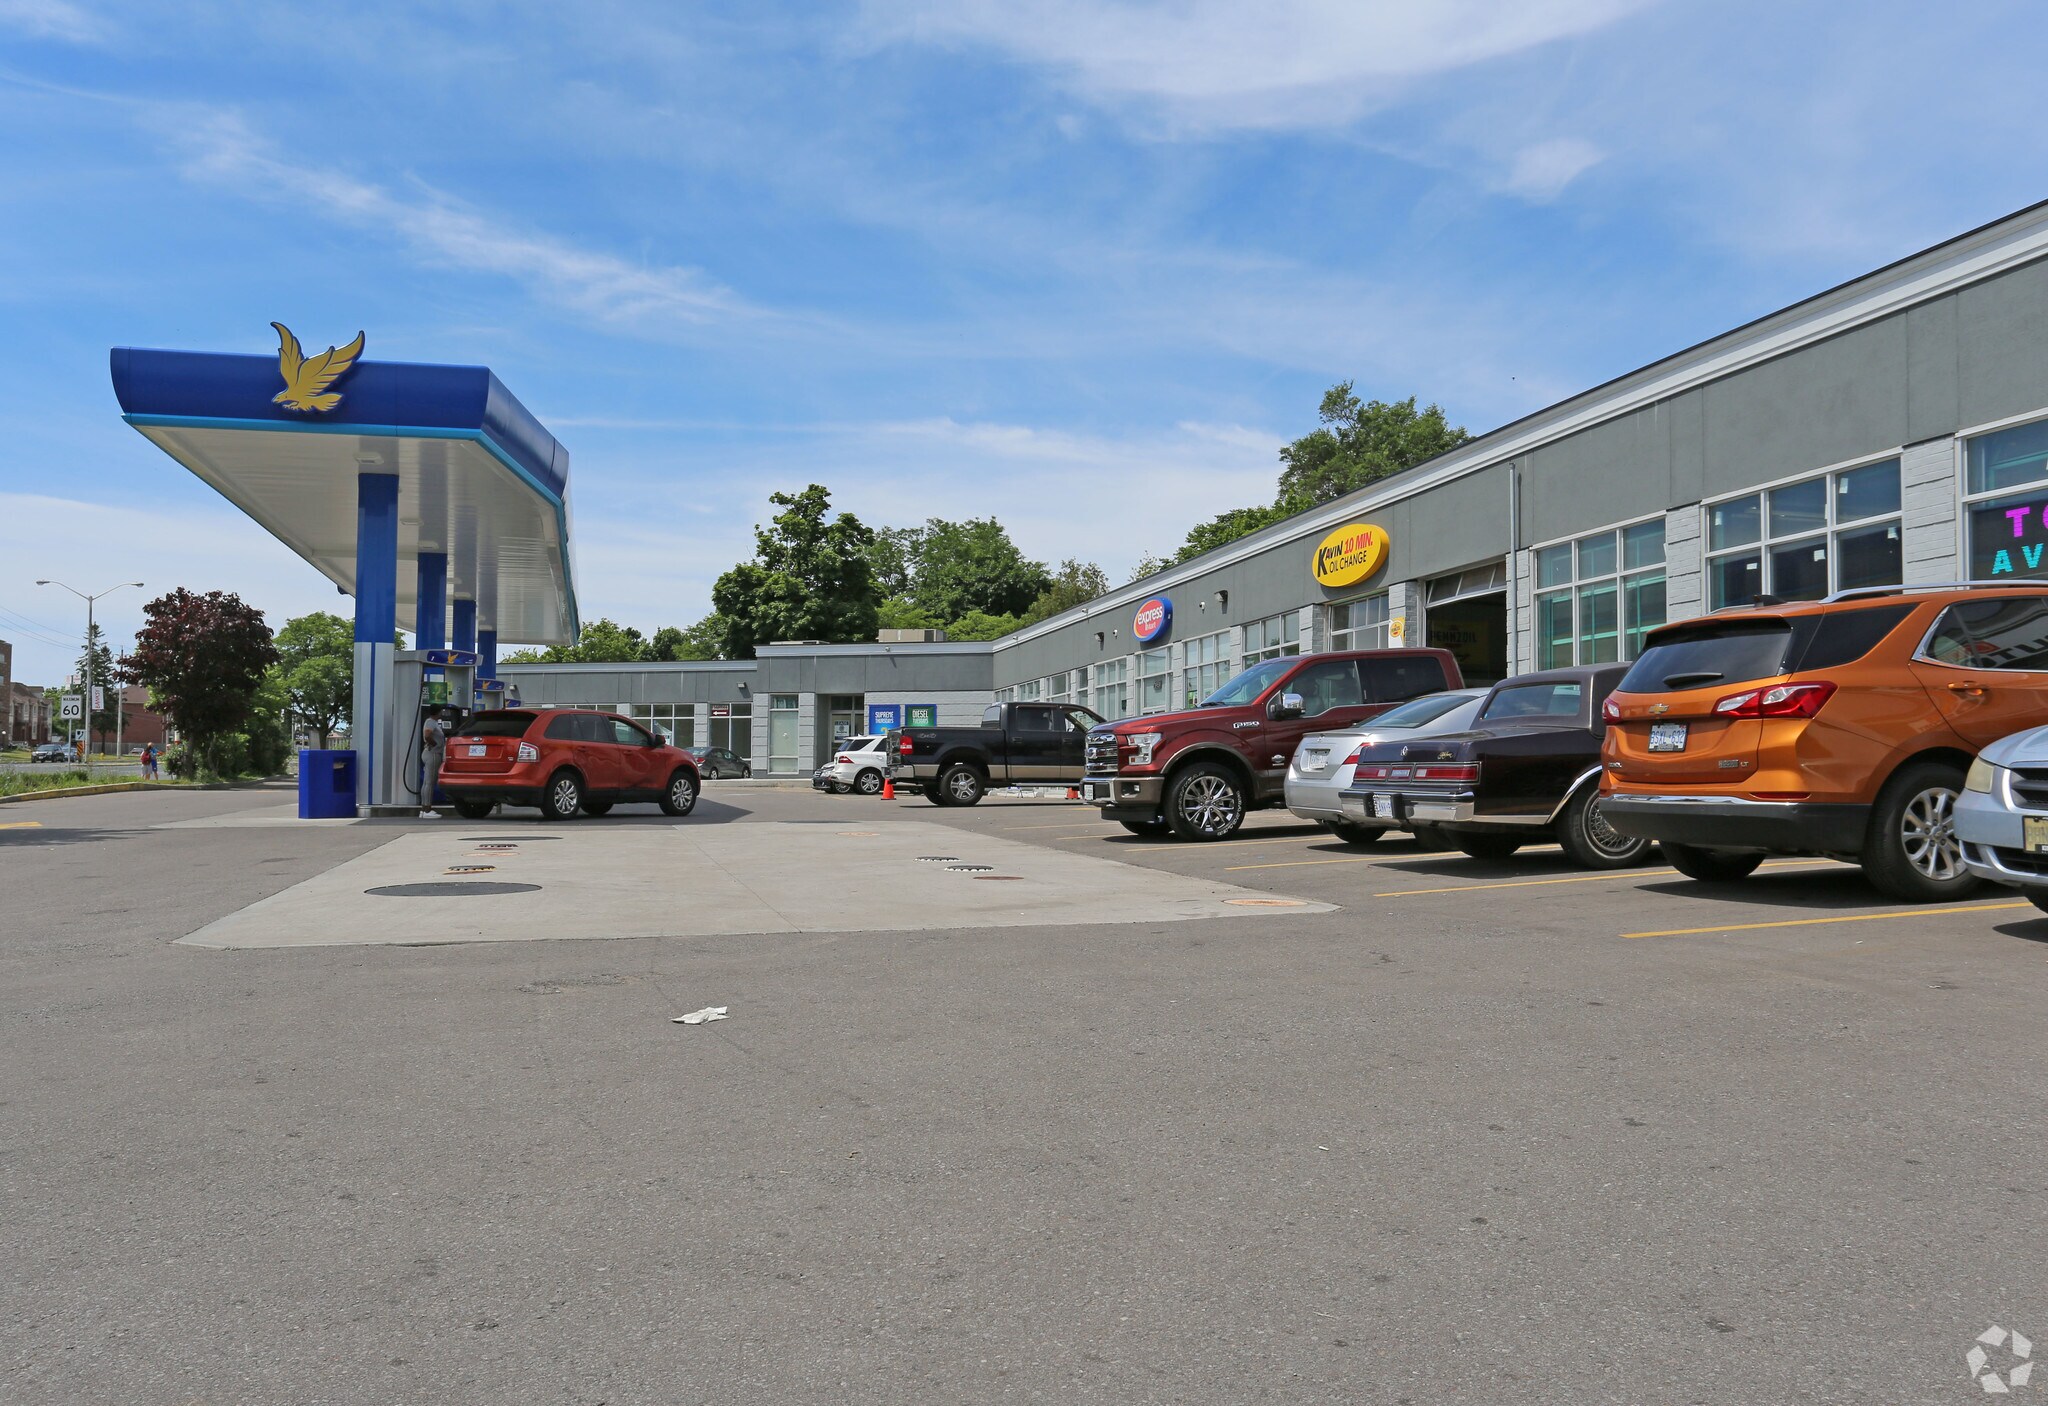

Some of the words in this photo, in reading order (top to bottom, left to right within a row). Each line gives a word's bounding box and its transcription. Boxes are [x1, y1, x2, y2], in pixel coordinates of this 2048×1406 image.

[2005, 504, 2048, 538] T
[1344, 537, 1355, 555] 10
[1355, 531, 1373, 551] MIN.
[1329, 559, 1339, 574] OIL
[1339, 550, 1367, 570] CHANGE
[1137, 605, 1163, 625] express
[63, 705, 79, 716] 60
[912, 709, 929, 718] DIESEL
